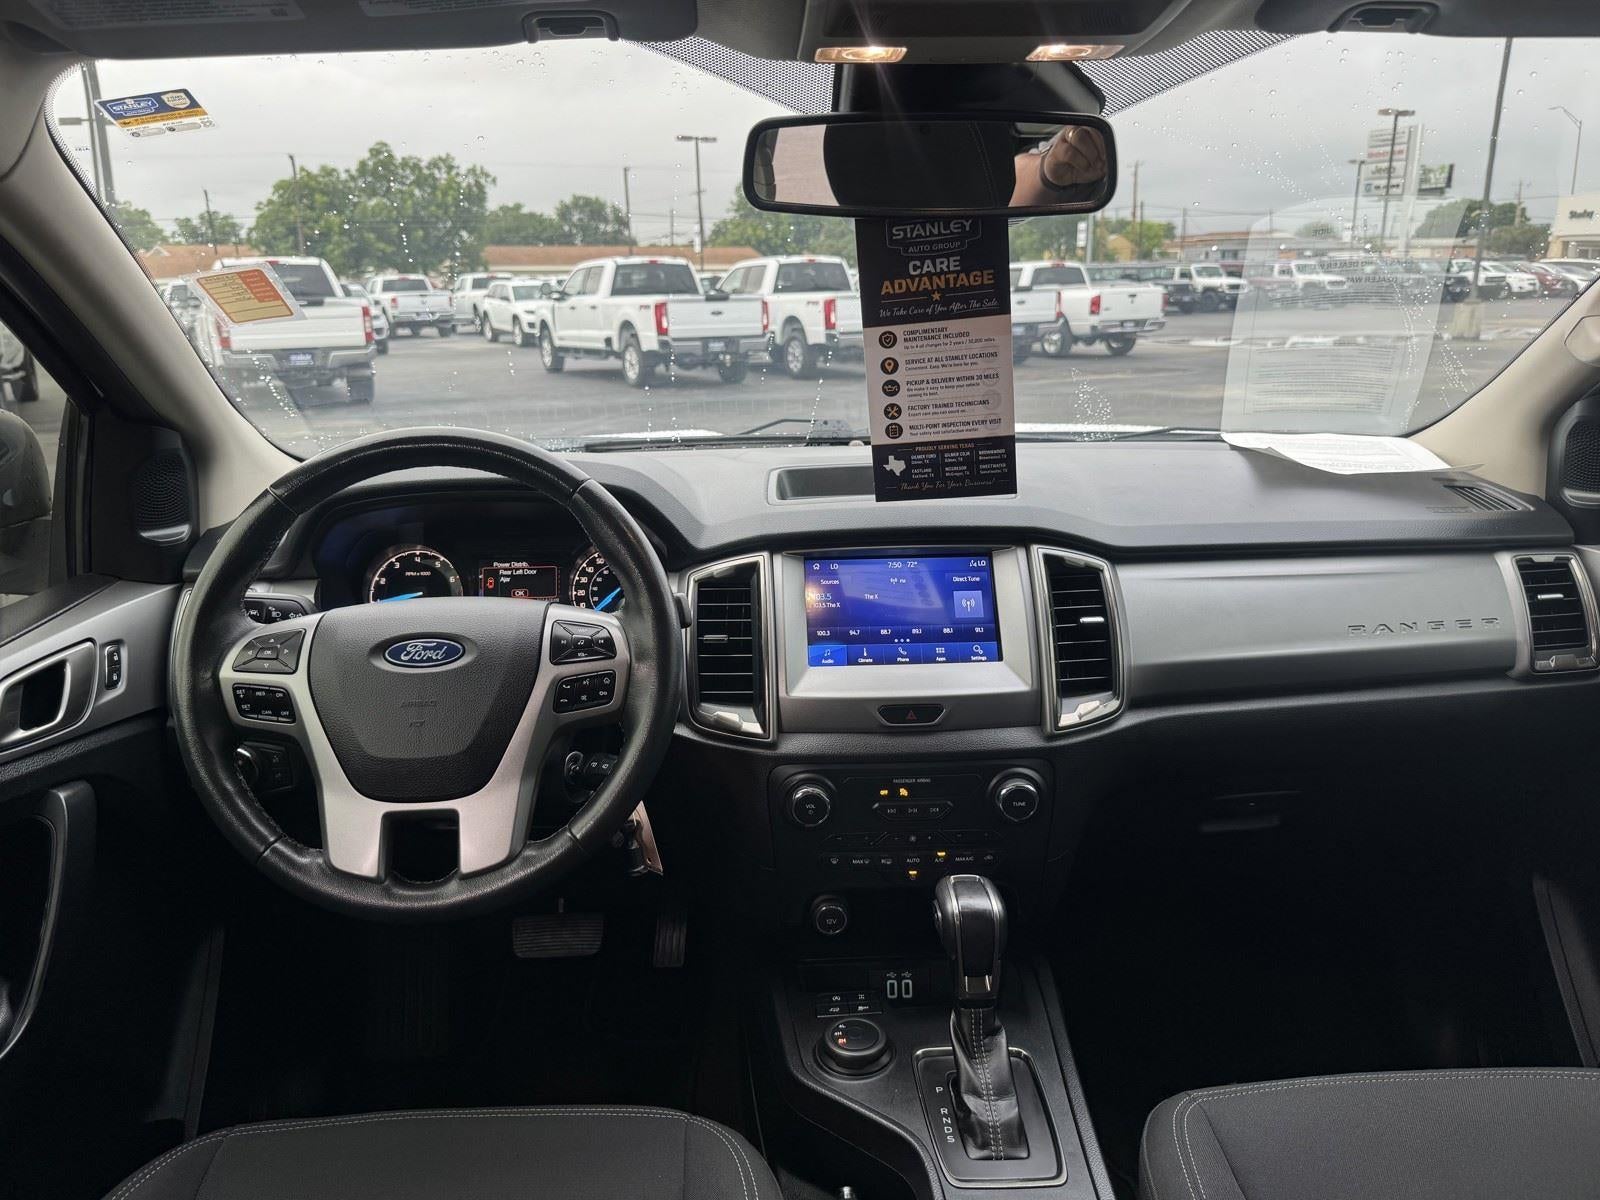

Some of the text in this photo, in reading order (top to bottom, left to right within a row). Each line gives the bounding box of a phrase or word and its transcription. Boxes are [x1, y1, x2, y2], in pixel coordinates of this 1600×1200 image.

[113, 100, 152, 111] STANLEY
[893, 219, 972, 239] STANLEY
[909, 242, 961, 253] AUTO GROUP
[909, 256, 961, 275] CARE
[881, 269, 995, 295] ADVANTAGE
[909, 306, 924, 315] Care
[926, 304, 933, 314] of
[935, 304, 947, 314] You
[950, 302, 967, 311] After
[969, 300, 981, 308] The
[903, 327, 948, 336] COMPLIMENTARY
[904, 331, 970, 343] MAINTENANCE INCLUDED
[947, 481, 962, 489] Your
[1348, 617, 1500, 635] RANGER
[401, 642, 447, 661] Ford
